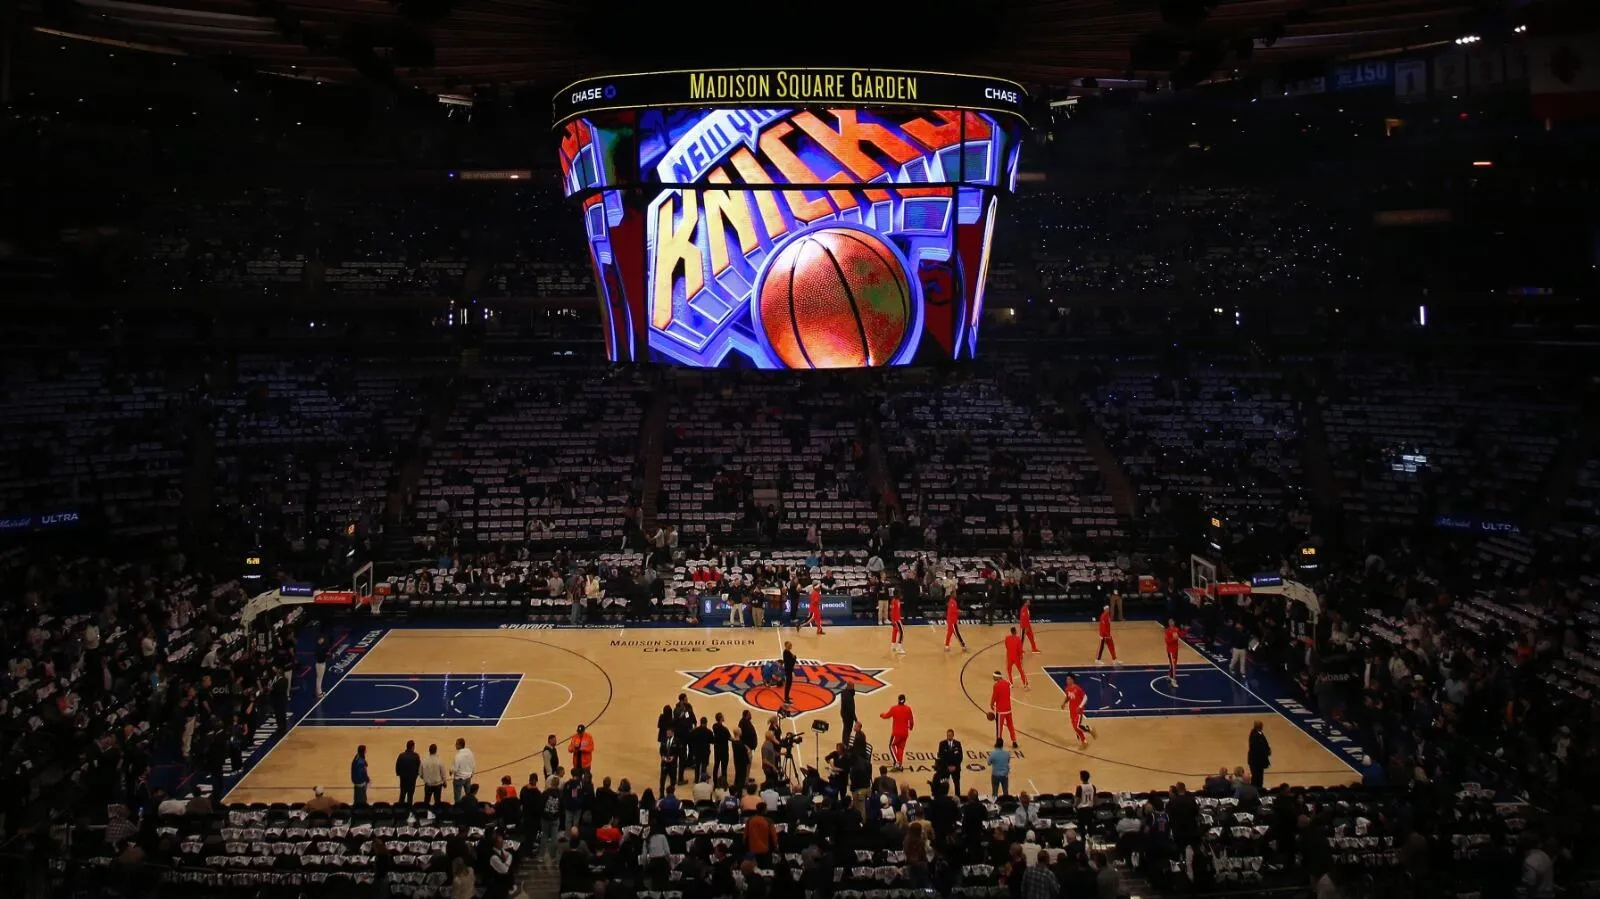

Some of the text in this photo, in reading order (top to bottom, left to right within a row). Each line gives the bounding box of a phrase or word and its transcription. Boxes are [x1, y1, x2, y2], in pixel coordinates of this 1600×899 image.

[689, 71, 918, 100] MADISON SQUARE GARDEN
[572, 88, 602, 104] CHASE
[984, 87, 1017, 103] CHASE
[673, 123, 732, 183] NEW
[41, 513, 80, 524] ULTRA
[609, 638, 756, 647] MADISON SQUARE GARDEN
